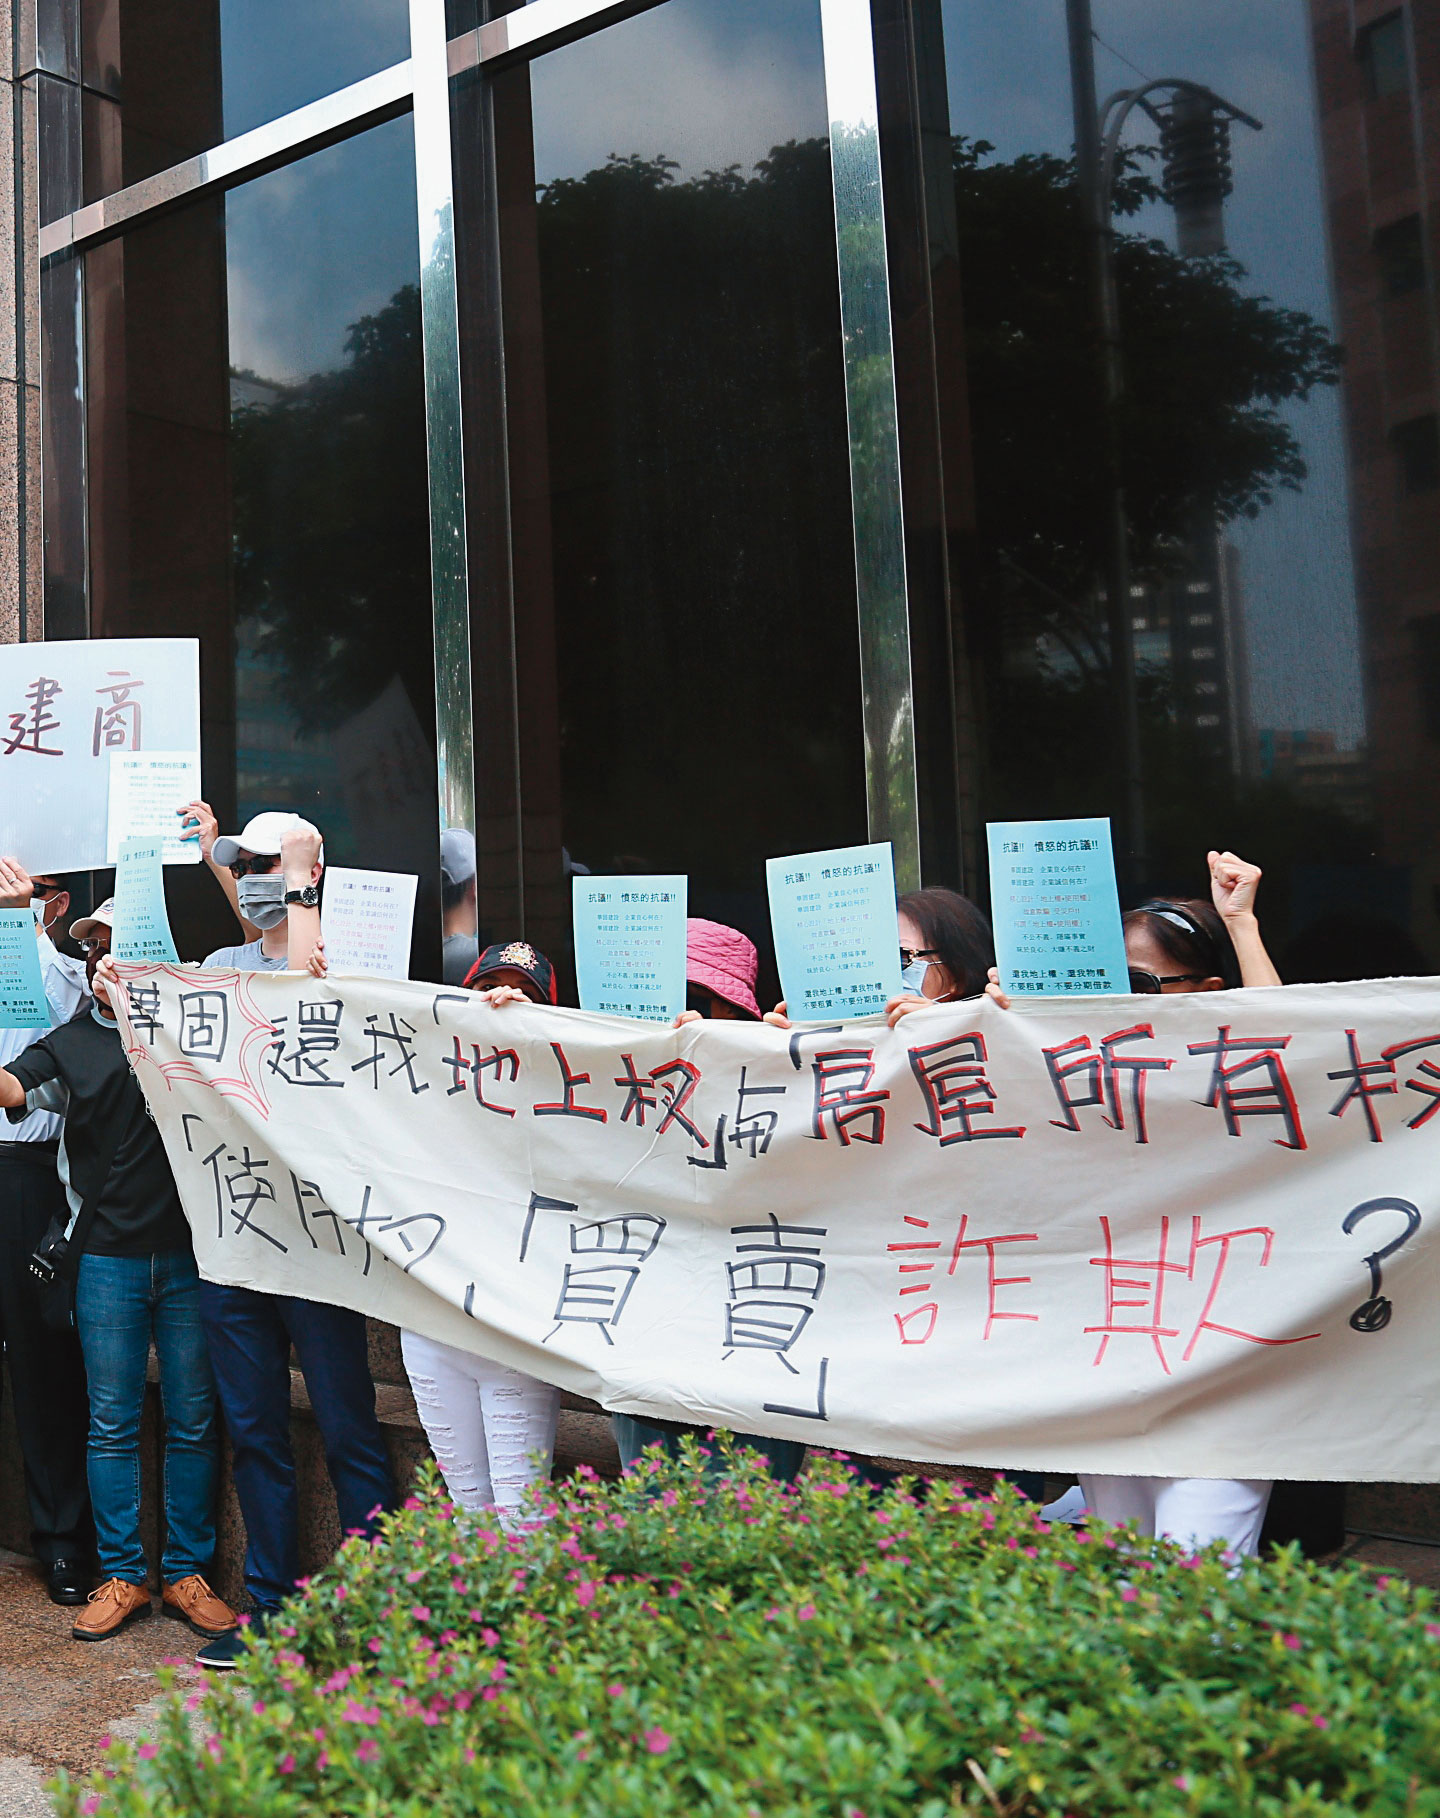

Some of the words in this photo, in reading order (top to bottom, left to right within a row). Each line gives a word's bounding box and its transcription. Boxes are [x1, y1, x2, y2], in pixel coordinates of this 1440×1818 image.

[1003, 841, 1024, 854] 抗議!!
[1034, 840, 1099, 853] 憤怒的抗議!!
